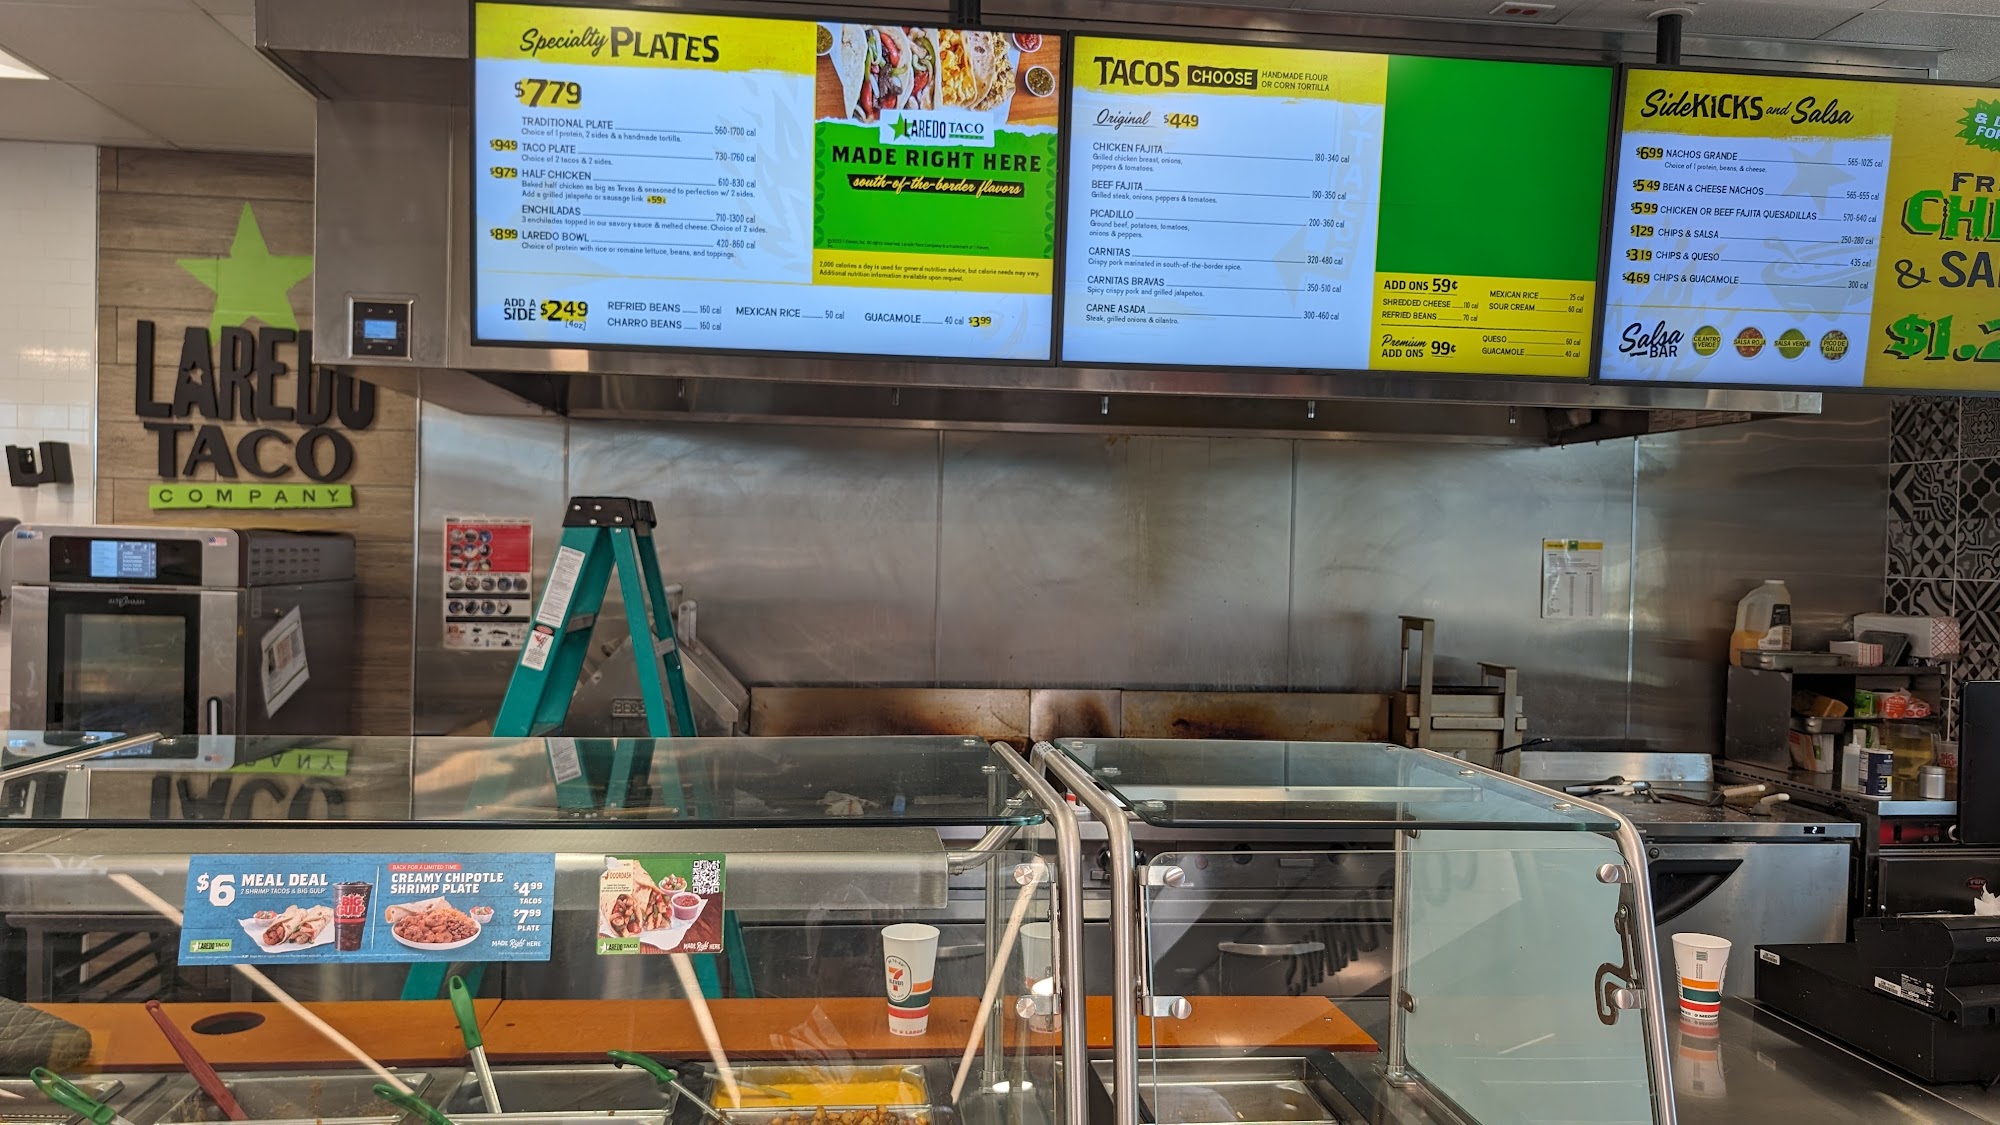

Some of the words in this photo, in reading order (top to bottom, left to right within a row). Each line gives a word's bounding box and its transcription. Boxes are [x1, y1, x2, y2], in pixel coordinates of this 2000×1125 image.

[520, 26, 608, 57] Specialty
[611, 26, 719, 63] PLATES
[1094, 57, 1180, 87] TACOS
[1192, 69, 1252, 85] CHOOSE
[1262, 71, 1303, 80] HANDMADE
[1305, 73, 1328, 81] FLOUR
[1273, 82, 1295, 90] CORN
[1298, 83, 1329, 91] TORTILLA
[515, 79, 582, 107] $779
[1766, 102, 1792, 116] and
[1791, 96, 1854, 124] Salsa
[522, 117, 583, 129] TRADITIONAL
[586, 119, 613, 129] PLATE
[1096, 109, 1151, 130] Original
[1164, 114, 1198, 128] $449
[1975, 113, 1988, 124] &
[715, 126, 744, 136] 560-1700
[746, 127, 756, 136] cal
[904, 118, 945, 139] LAREDO
[949, 122, 984, 133] TACO
[490, 139, 518, 151] $949
[522, 143, 545, 152] TACO
[548, 144, 576, 154] PLATE
[1093, 142, 1133, 152] CHICKEN
[1135, 144, 1163, 153] FAJITA
[1315, 154, 1339, 162] 180-340
[1341, 154, 1349, 163] cal
[1636, 147, 1663, 159] $699
[1666, 149, 1701, 159] NACHOS
[1704, 151, 1737, 160] GRANDE
[832, 146, 896, 165] MADE
[906, 150, 975, 169] RIGHT
[983, 154, 1041, 172] HERE
[490, 167, 517, 178] $979
[522, 169, 546, 178] HALF
[548, 170, 591, 180] CHICKEN
[853, 174, 975, 193] south-of-the-border
[976, 182, 1022, 198] flavors
[1092, 180, 1113, 189] BEEF
[1115, 181, 1142, 190] FAJITA
[1632, 180, 1660, 191] $549
[1951, 172, 2000, 193] FR
[1663, 182, 1684, 192] BEAN
[1687, 184, 1693, 192] &
[1695, 184, 1727, 194] CHEESE
[1729, 185, 1763, 195] NACHOS
[522, 205, 581, 216] ENCHILADAS
[1090, 209, 1133, 219] PICADILLO
[1631, 203, 1657, 214] $599
[1661, 205, 1697, 214] CHICKEN
[1700, 207, 1712, 215] OR
[1714, 207, 1734, 216] BEEF
[1736, 209, 1761, 218] FAJITA
[1763, 209, 1817, 220] QUESADILLAS
[490, 228, 517, 240] $899
[522, 230, 559, 241] LAREDO
[562, 232, 589, 242] BOWL
[1630, 225, 1654, 238] $129
[1658, 228, 1683, 238] CHIPS
[1686, 229, 1691, 238] &
[1694, 230, 1719, 239] SALSA
[1089, 247, 1130, 256] CARNITAS
[1626, 250, 1652, 261] $319
[1656, 251, 1681, 260] CHIPS
[1683, 253, 1689, 261] &
[1691, 252, 1719, 261] QUESO
[1894, 259, 1932, 289] &
[1938, 251, 2000, 288] SA
[1087, 276, 1129, 285] CARNITAS
[1132, 277, 1164, 286] BRAVAS
[1622, 272, 1650, 283] $469
[1654, 274, 1679, 282] CHIPS
[1681, 275, 1687, 283] &
[1690, 274, 1739, 284] GUACAMOLE
[1384, 281, 1405, 290] ADD
[1409, 281, 1428, 291] ONS
[1432, 278, 1457, 292] 59¢
[504, 298, 526, 307] ADD
[529, 299, 536, 308] A
[608, 301, 646, 311] REFRIED
[650, 302, 680, 313] BEANS
[1086, 304, 1115, 313] CARNE
[1118, 305, 1145, 313] ASADA
[1383, 298, 1421, 307] SHREDDED
[1423, 300, 1450, 308] CHEESE
[504, 308, 536, 321] SIDE
[541, 300, 588, 321] $249
[736, 307, 780, 317] MEXICAN
[783, 308, 800, 318] RICE
[608, 318, 648, 328] CHARRO
[650, 319, 682, 329] BEANS
[865, 313, 921, 324] GUACAMOLE
[969, 317, 991, 327] $399
[1382, 334, 1427, 347] Premium
[1482, 335, 1506, 343] QUESO
[1619, 321, 1684, 353] Salsa
[1382, 349, 1402, 358] ADD
[1406, 349, 1423, 358] ONS
[1431, 341, 1456, 355] 99¢
[1482, 348, 1524, 356] GUACAMOLE
[1650, 346, 1677, 358] BAR
[144, 422, 353, 482] TACO
[159, 489, 338, 503] COMPANY
[242, 874, 284, 886] MEAL
[289, 874, 329, 886] DEAL
[391, 873, 443, 883] CREAMY
[444, 872, 504, 882] CHIPOTLE
[196, 872, 235, 906] $6
[391, 883, 440, 894] SHRIMP
[443, 883, 480, 893] PLATE
[513, 882, 543, 897] $499
[342, 895, 361, 906] BIG
[337, 905, 365, 917] GULP
[513, 909, 541, 924] $799
[198, 942, 214, 950] LAREDO
[510, 939, 525, 948] Right
[606, 943, 622, 951] LAREDO
[697, 941, 709, 951] Right
